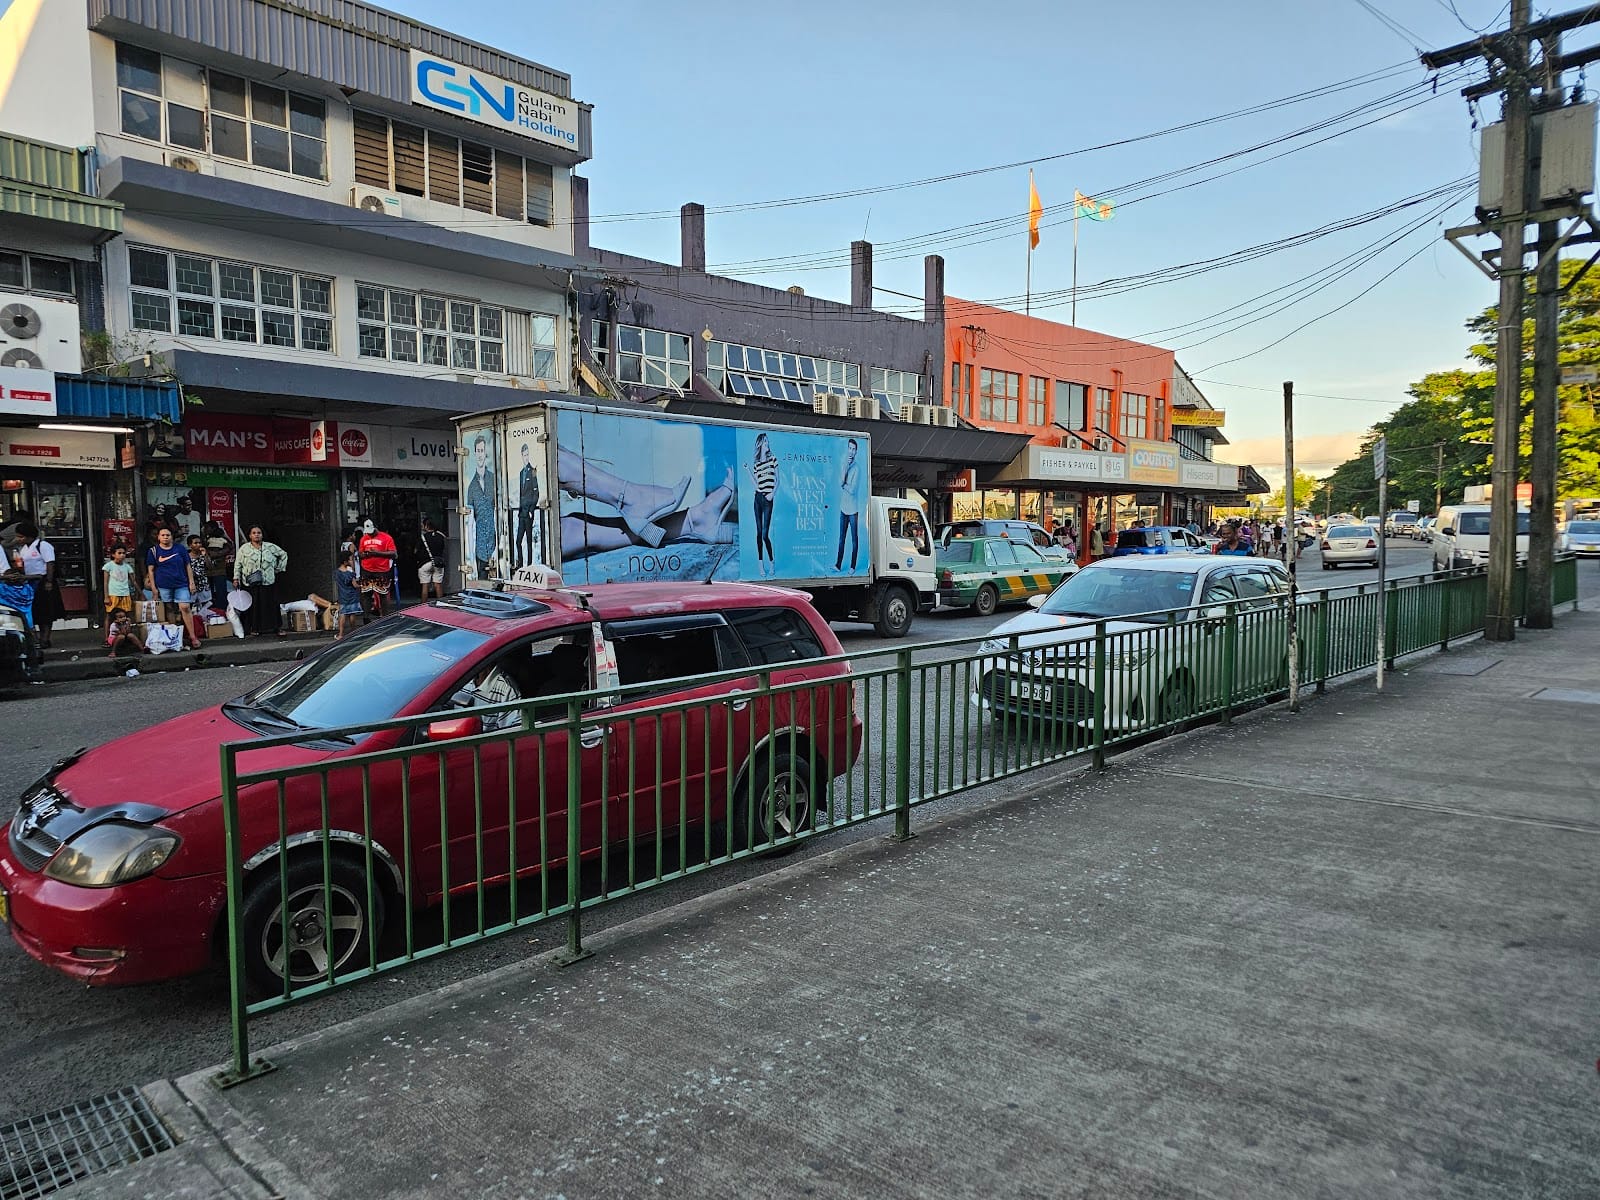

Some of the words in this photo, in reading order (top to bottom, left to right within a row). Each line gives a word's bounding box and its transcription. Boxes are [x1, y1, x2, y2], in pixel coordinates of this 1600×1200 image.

[518, 91, 566, 115] Gulam
[518, 104, 552, 123] Nabi
[518, 115, 575, 144] Holding
[190, 428, 268, 449] MAN'S
[512, 426, 539, 438] CONNOR
[411, 437, 459, 462] Lovely
[783, 453, 833, 463] JEANSWEST
[1042, 459, 1067, 468] FISHER
[1074, 462, 1097, 470] PAYKEL
[1112, 463, 1121, 471] LG
[1186, 467, 1214, 481] Hisense
[791, 471, 827, 490] JEANS
[791, 490, 826, 504] WEST
[797, 503, 825, 517] FITS
[796, 517, 825, 531] BEST
[629, 554, 681, 573] novo
[518, 570, 543, 585] TAXI
